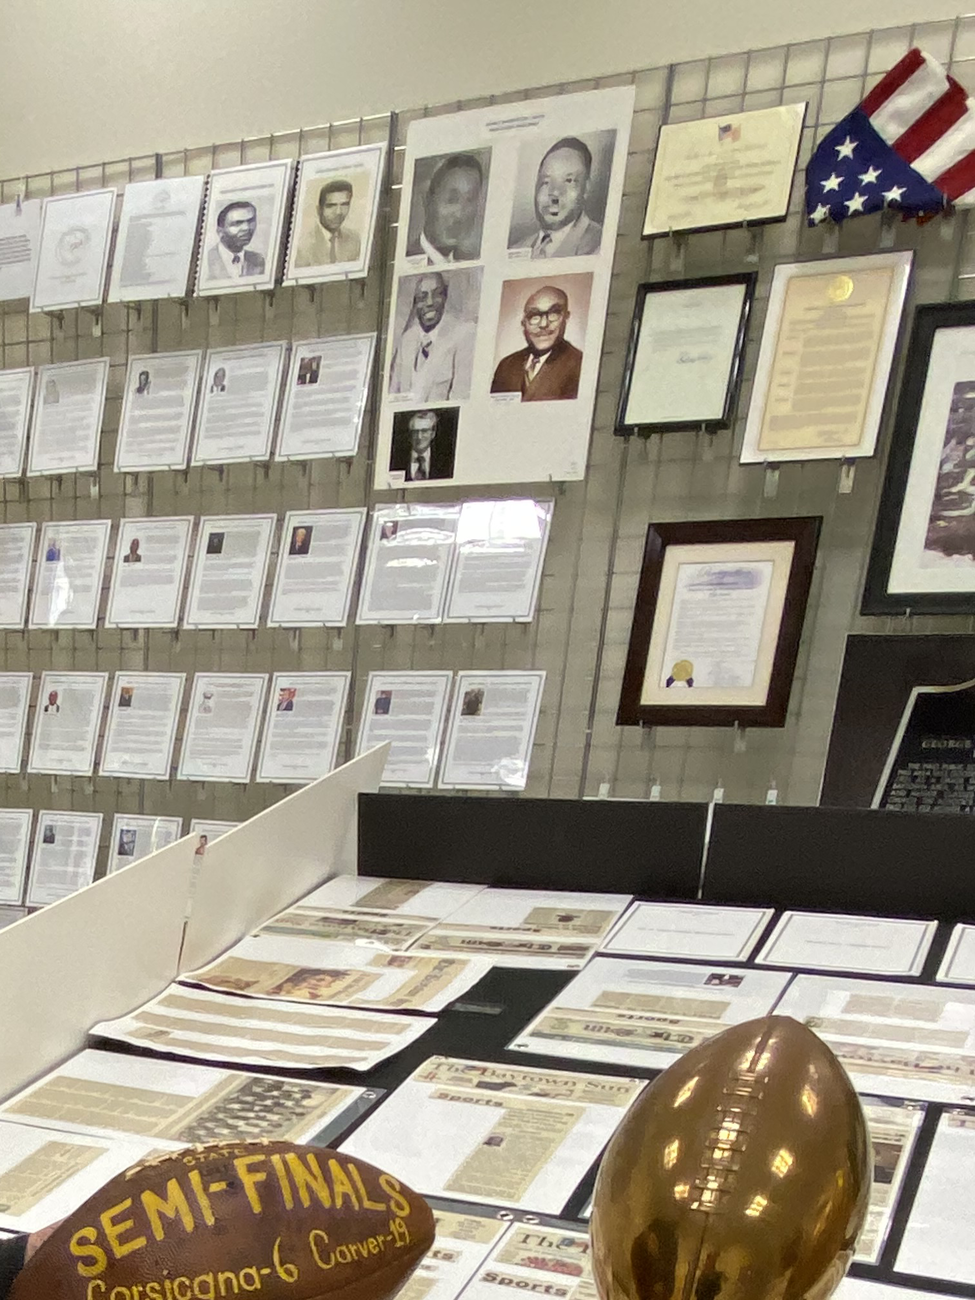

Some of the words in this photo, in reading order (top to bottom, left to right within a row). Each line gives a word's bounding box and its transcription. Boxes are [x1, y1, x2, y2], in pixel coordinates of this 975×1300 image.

[481, 1066, 577, 1088] Baytown
[436, 1092, 504, 1107] Sports
[69, 1153, 410, 1277] SEMI-FINALS
[482, 1271, 569, 1297] Sports
